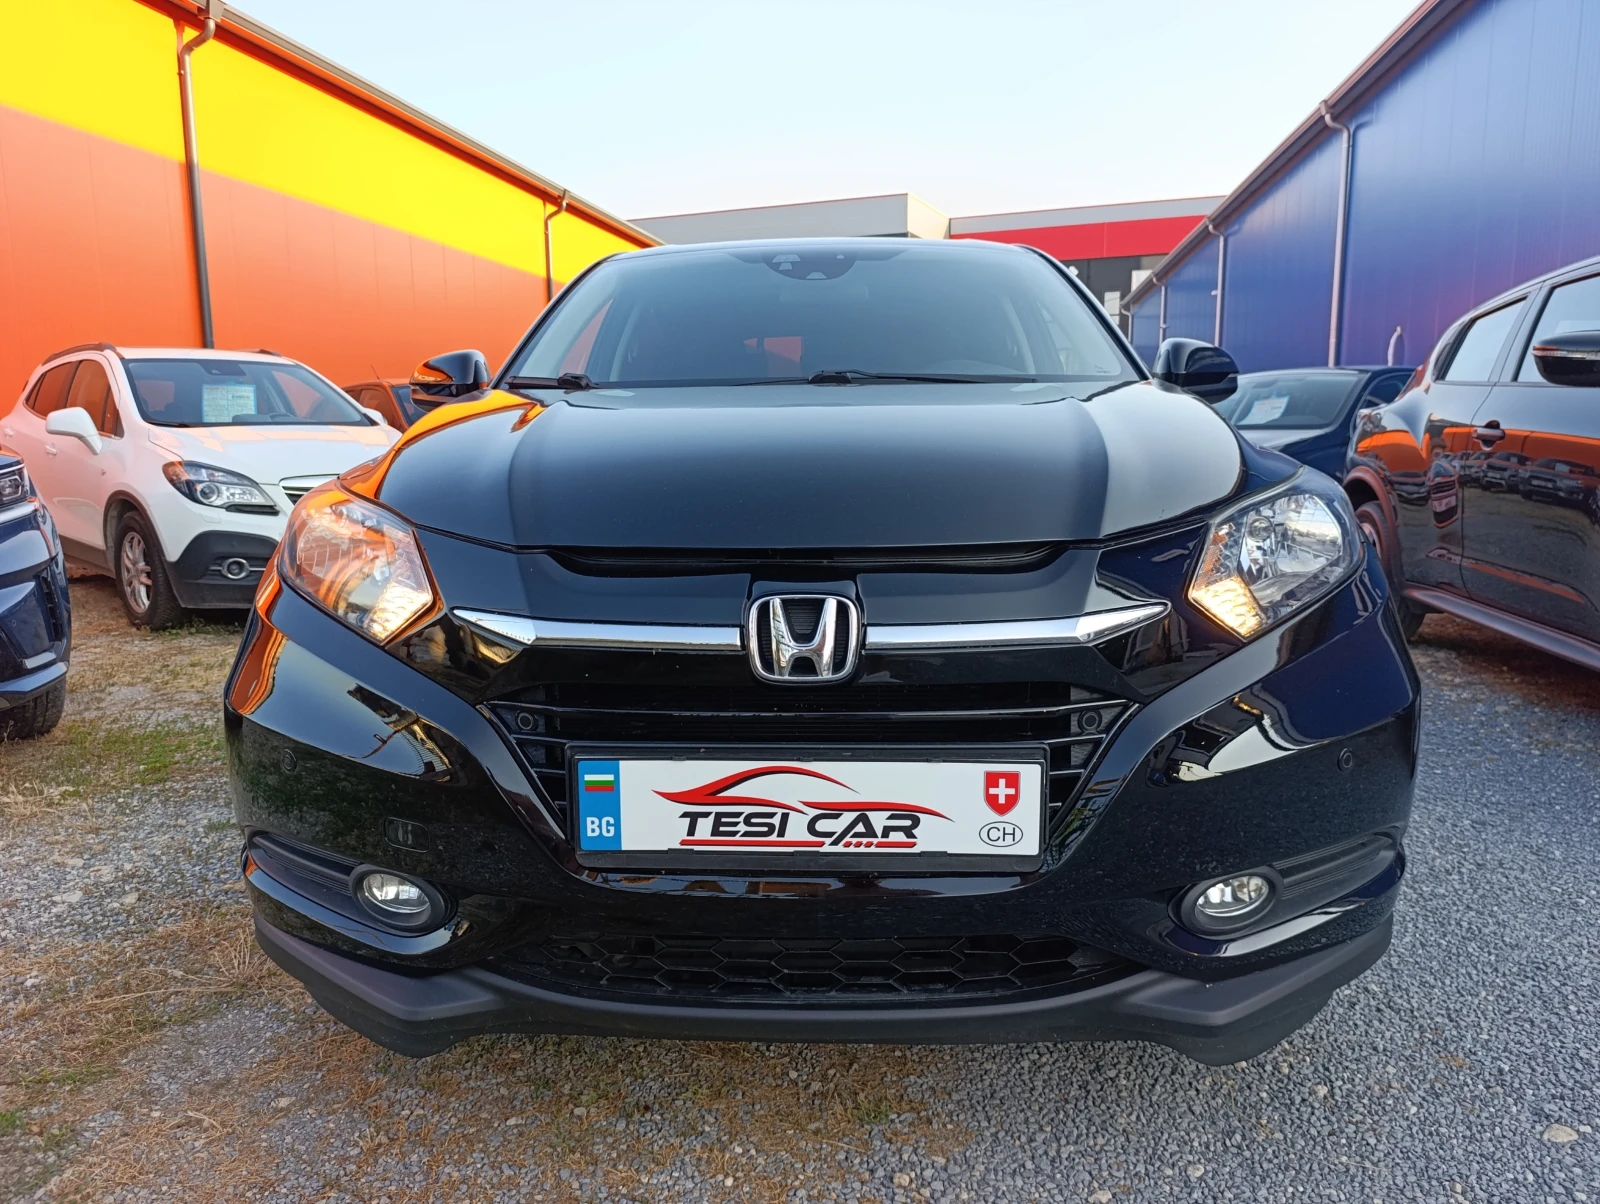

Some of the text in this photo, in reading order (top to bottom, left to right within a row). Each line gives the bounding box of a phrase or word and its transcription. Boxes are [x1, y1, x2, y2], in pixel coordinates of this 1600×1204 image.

[586, 816, 615, 837] BG
[678, 811, 921, 846] TESI CAR
[986, 826, 1016, 842] CH
